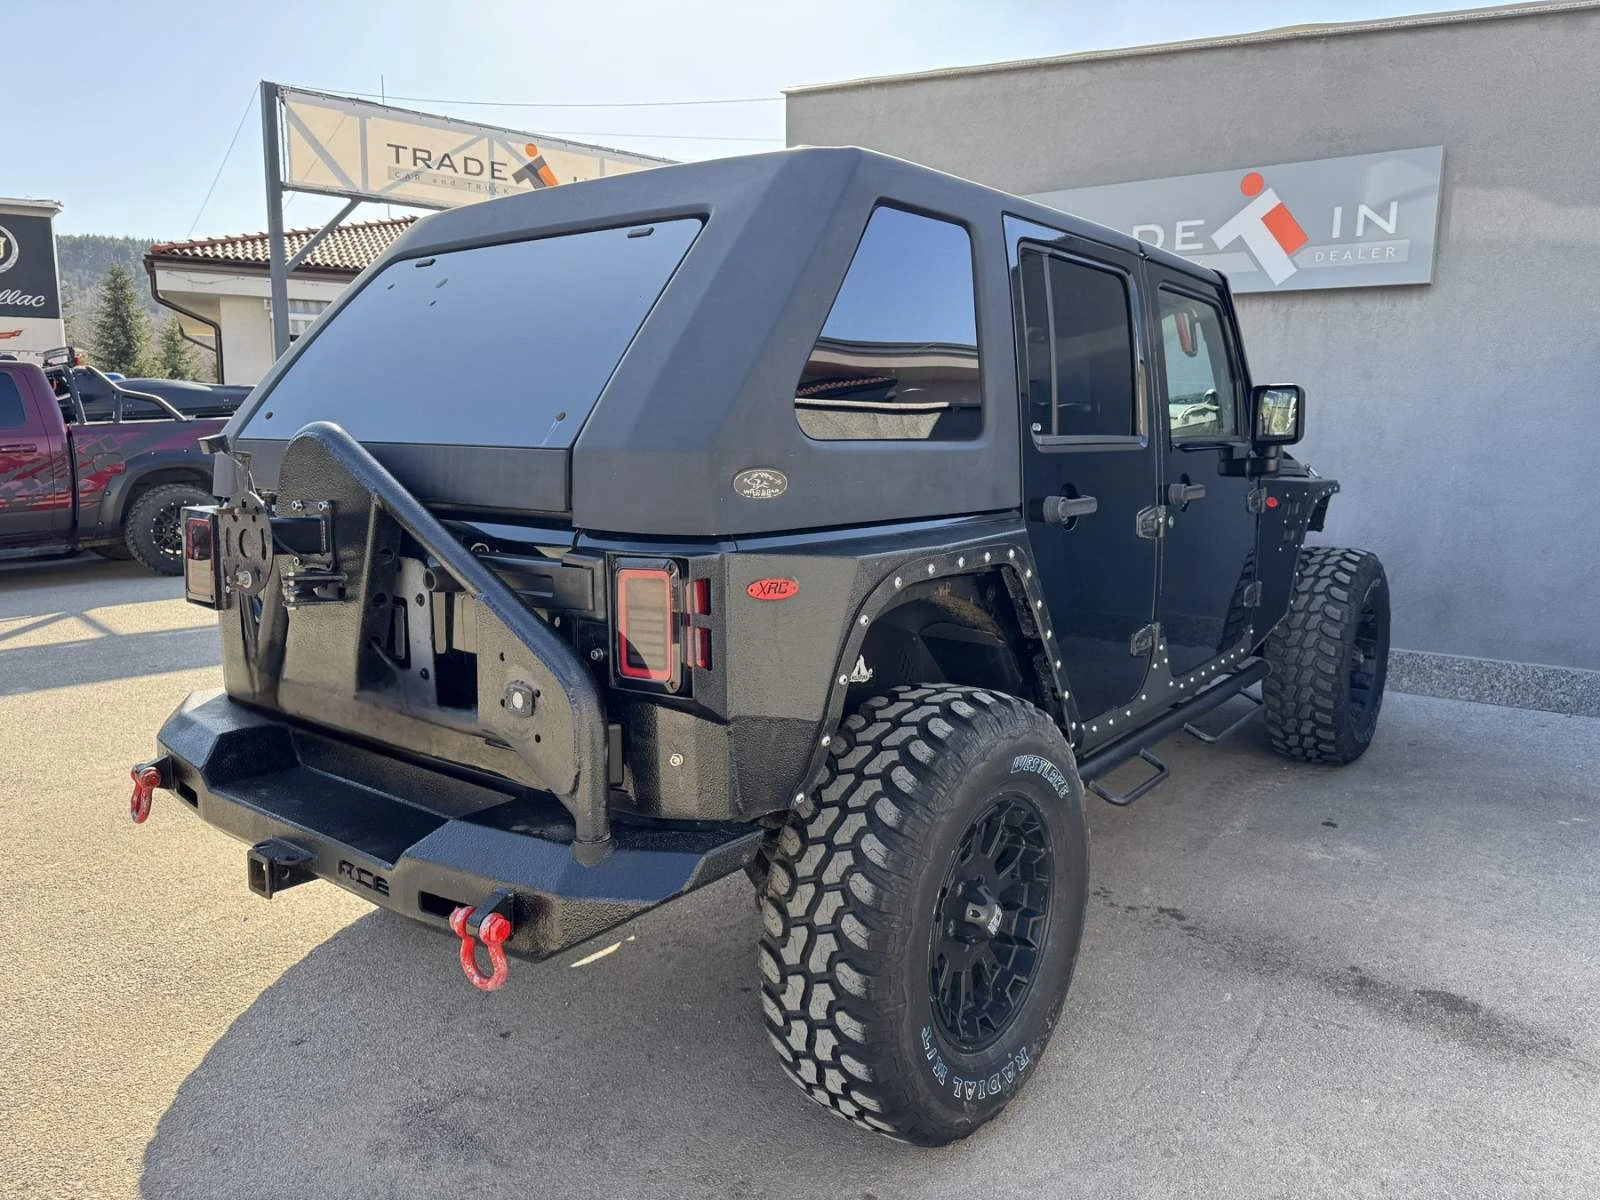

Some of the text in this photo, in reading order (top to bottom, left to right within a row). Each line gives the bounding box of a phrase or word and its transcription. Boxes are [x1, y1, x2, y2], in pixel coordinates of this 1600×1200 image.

[386, 143, 508, 181] TRADE
[394, 171, 422, 181] CAR
[432, 178, 456, 186] and
[1331, 200, 1398, 239] IN
[1314, 246, 1395, 262] DEALER
[0, 288, 45, 307] llac
[757, 581, 789, 597] XRC
[1010, 754, 1069, 799] WESTLAKE
[953, 1046, 1030, 1101] RADIAL
